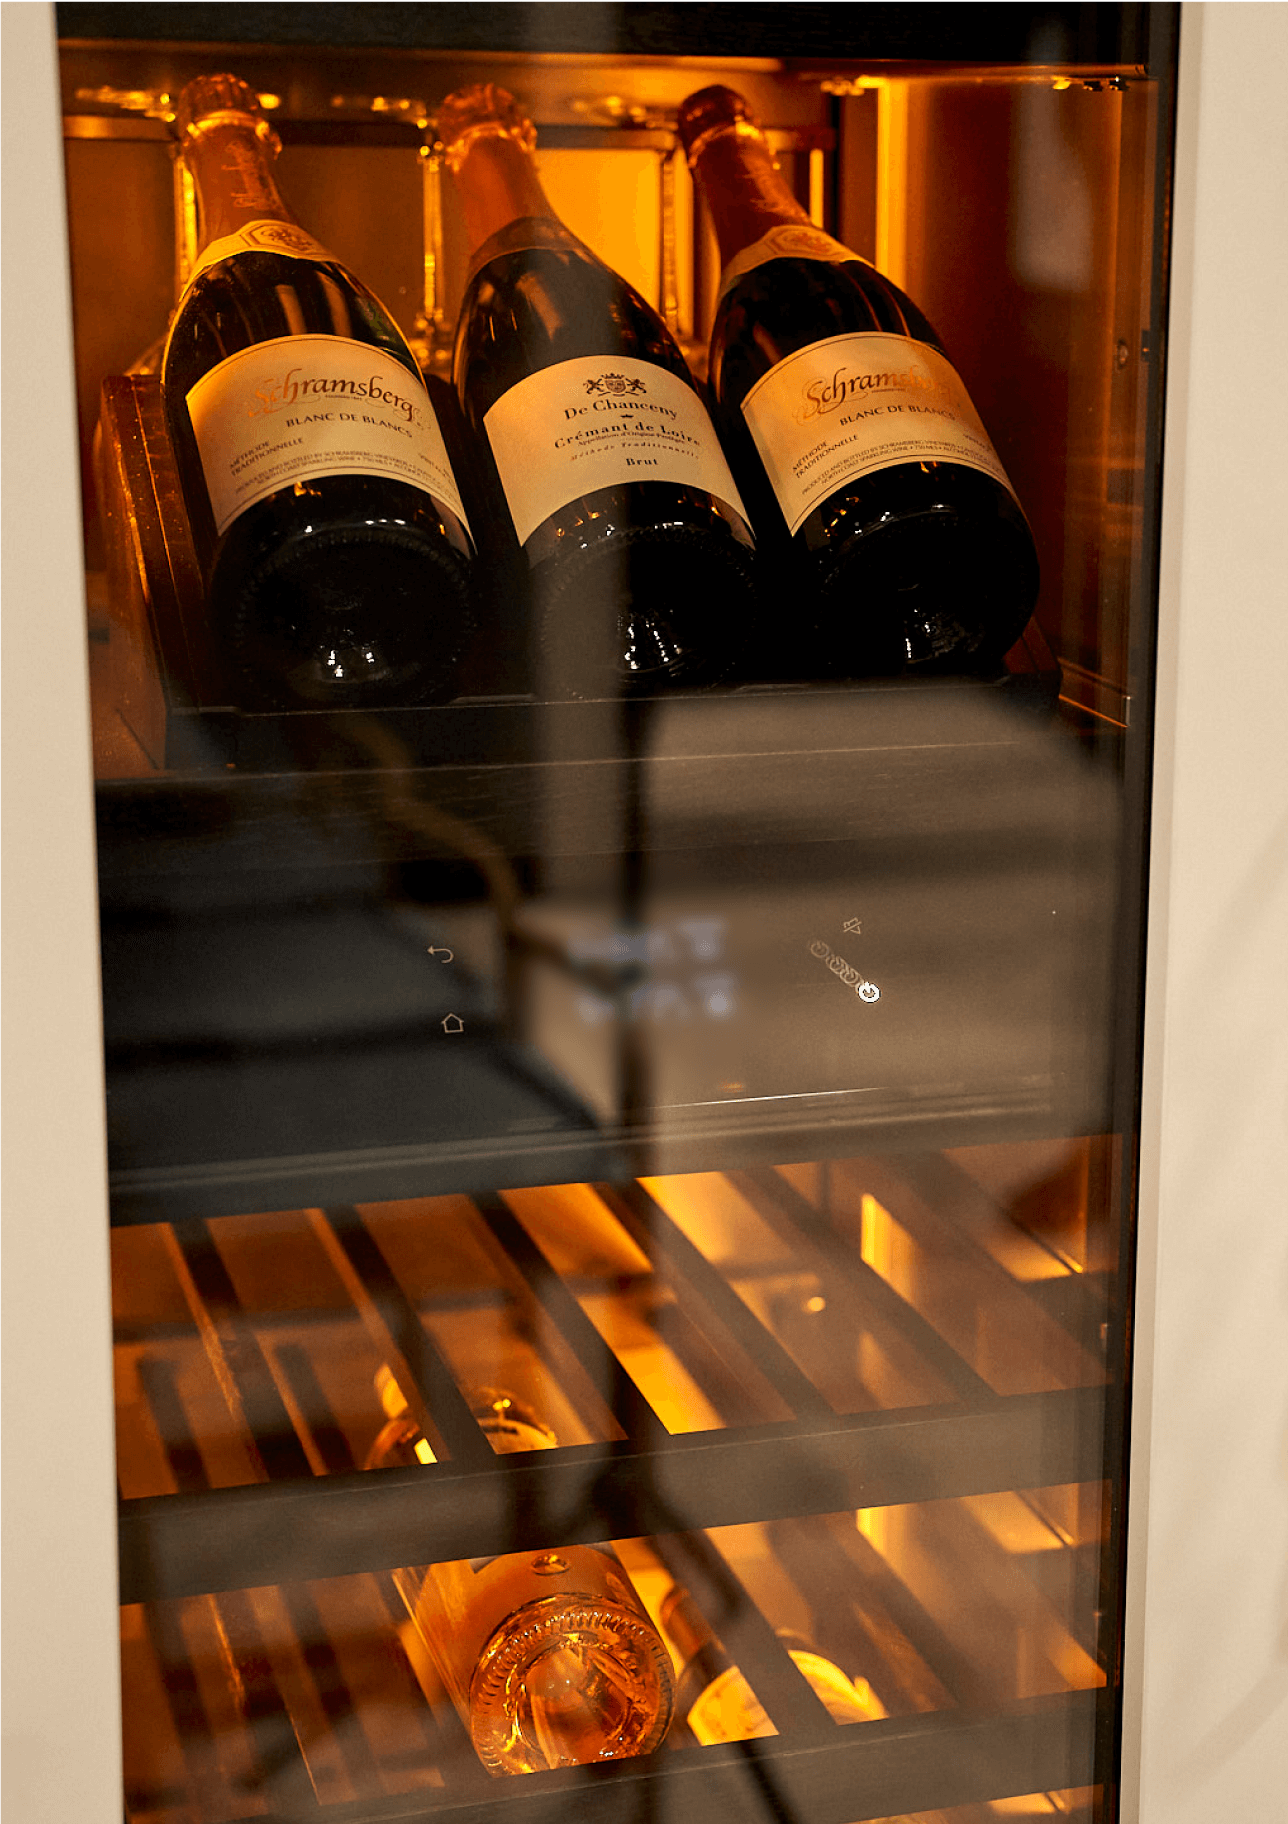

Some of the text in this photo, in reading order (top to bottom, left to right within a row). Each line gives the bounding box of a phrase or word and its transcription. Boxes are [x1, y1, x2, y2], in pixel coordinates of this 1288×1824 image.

[564, 399, 677, 420] De Chanceny
[840, 407, 884, 426] BLANC
[887, 405, 905, 413] DE
[286, 412, 413, 438] BLANC DE BLANCS
[554, 423, 628, 449] Crémant
[635, 421, 654, 431] de
[626, 458, 659, 466] Brut
[795, 434, 858, 478] TRADITIONNELLE
